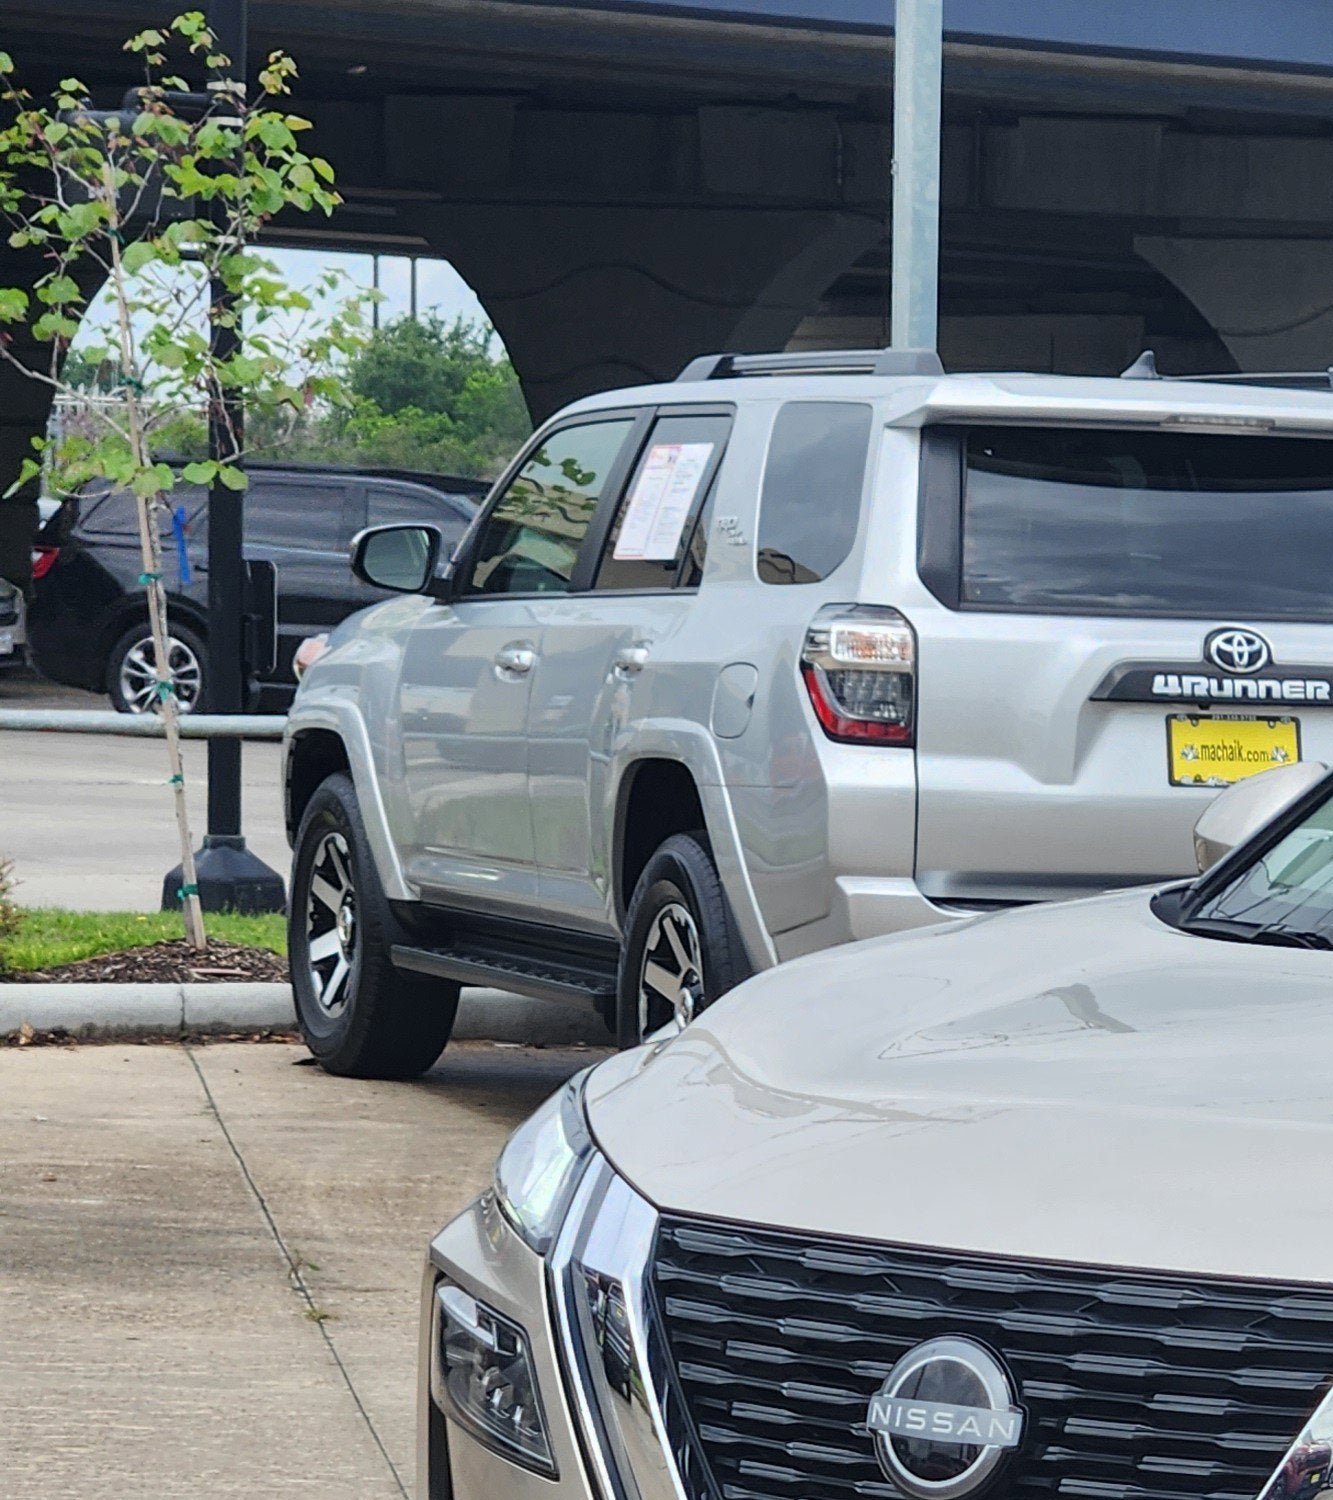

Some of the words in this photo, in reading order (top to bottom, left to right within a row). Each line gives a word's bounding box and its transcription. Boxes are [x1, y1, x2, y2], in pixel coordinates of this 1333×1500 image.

[1151, 674, 1331, 701] 4RUNNER
[1199, 739, 1270, 763] machaik.com
[871, 1402, 1015, 1441] NISSAN
